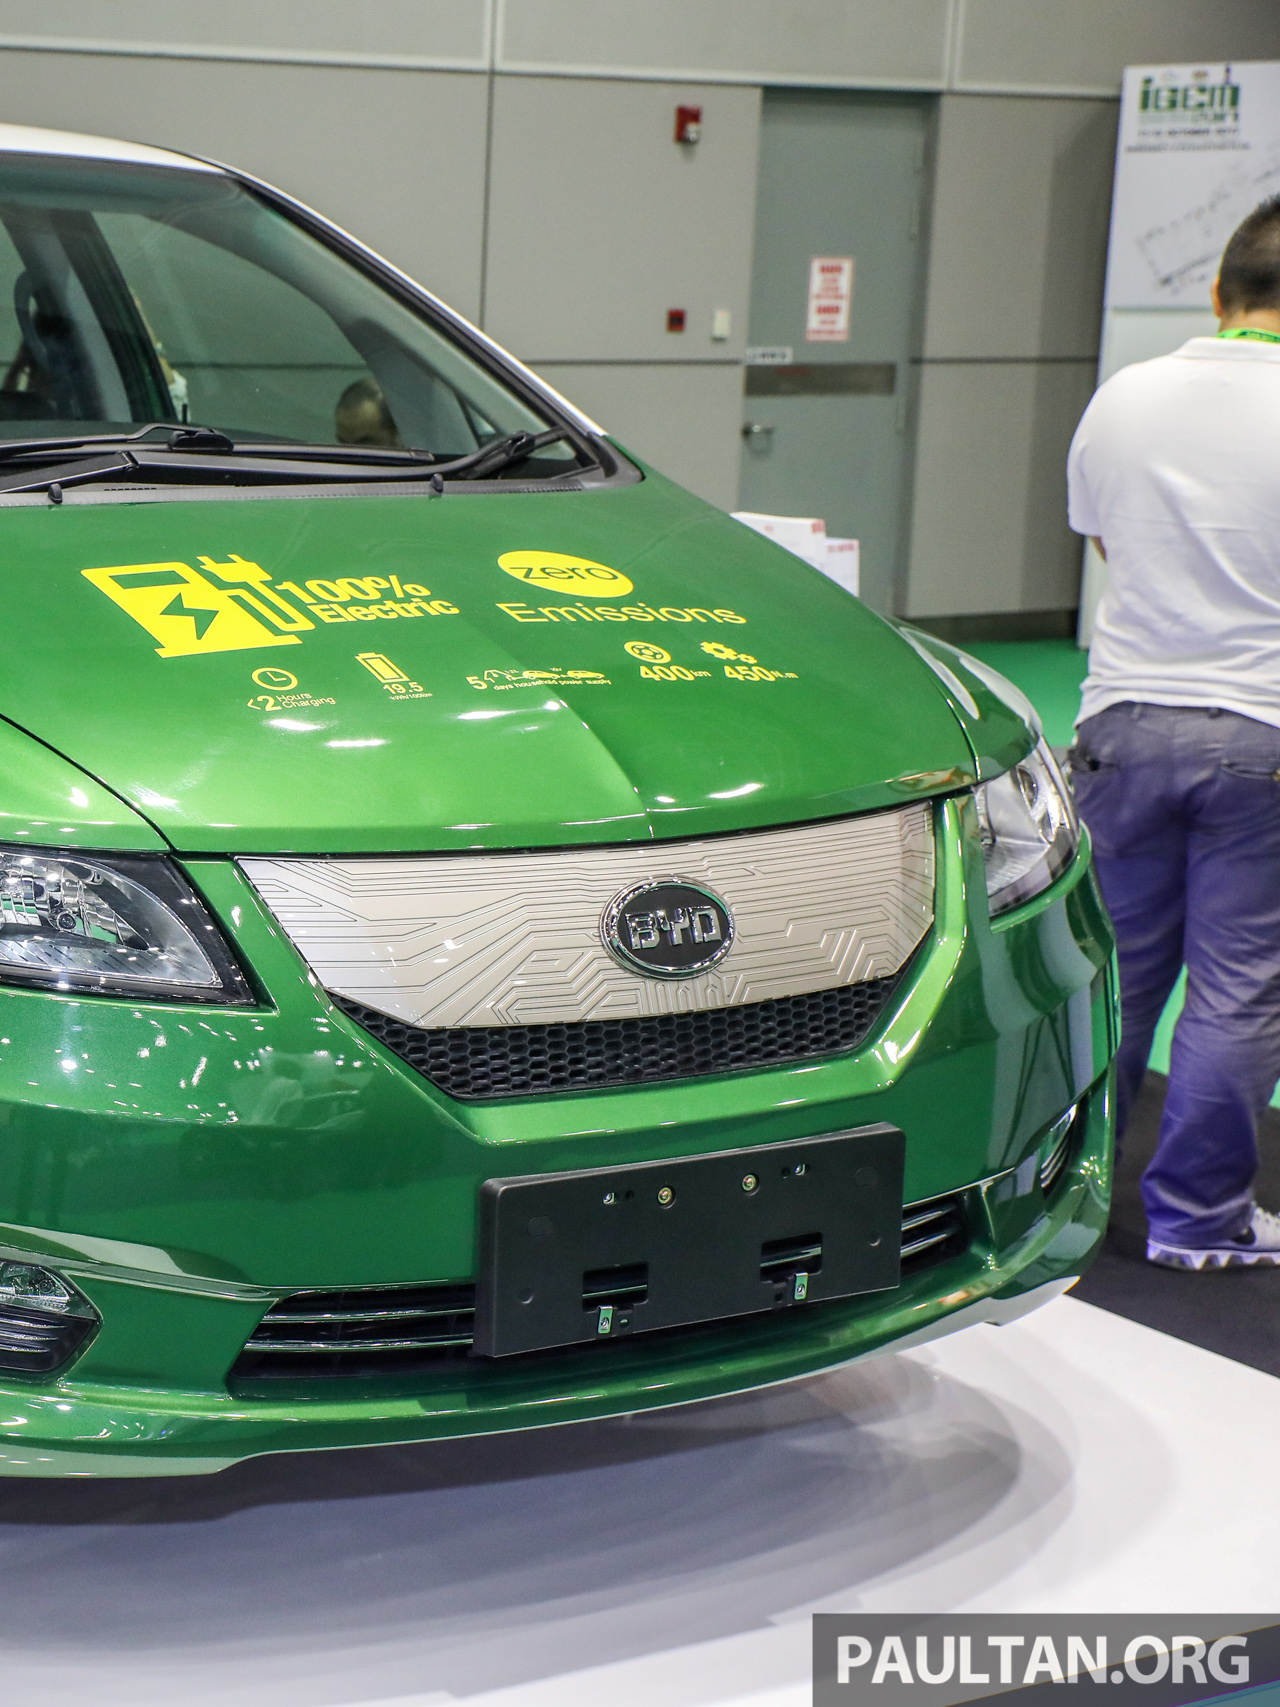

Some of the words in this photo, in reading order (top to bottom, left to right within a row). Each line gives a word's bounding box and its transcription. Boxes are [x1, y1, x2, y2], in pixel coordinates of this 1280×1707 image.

[509, 566, 618, 581] zero
[274, 575, 431, 604] 100%
[307, 599, 460, 624] Electric
[496, 602, 747, 625] Emissions
[382, 681, 424, 694] 19.5
[465, 675, 488, 690] 5
[275, 693, 312, 703] Hours
[282, 697, 336, 709] Charging
[625, 905, 722, 950] BYD
